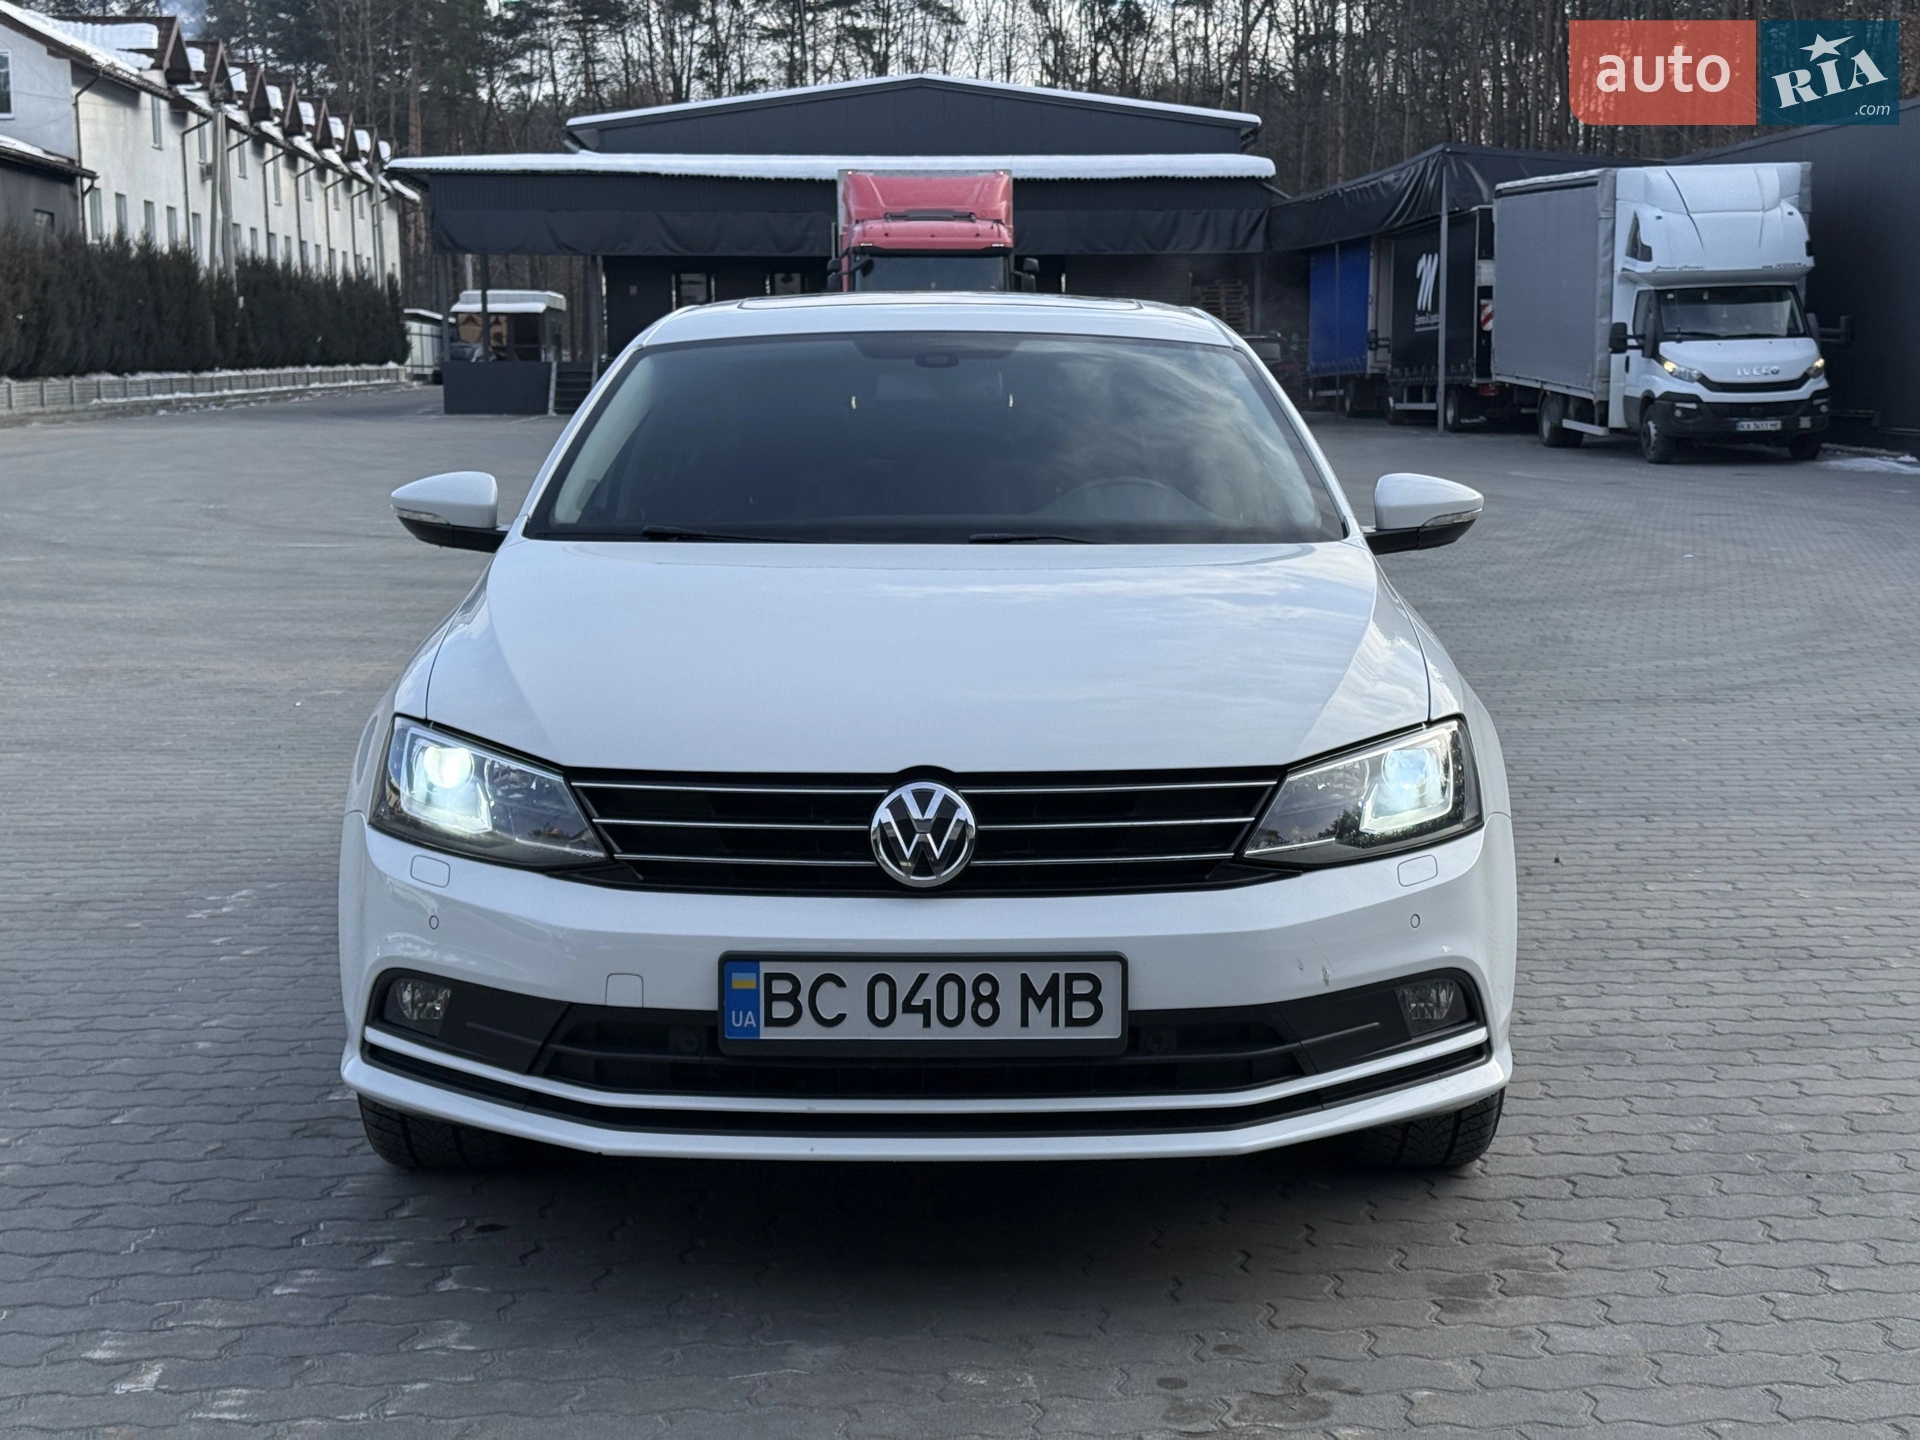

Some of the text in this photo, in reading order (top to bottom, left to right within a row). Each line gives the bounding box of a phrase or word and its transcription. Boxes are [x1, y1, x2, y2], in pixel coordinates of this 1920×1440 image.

[1736, 365, 1780, 377] IVECO
[764, 972, 1104, 1029] BC 0408 MB
[731, 1011, 757, 1028] UA
